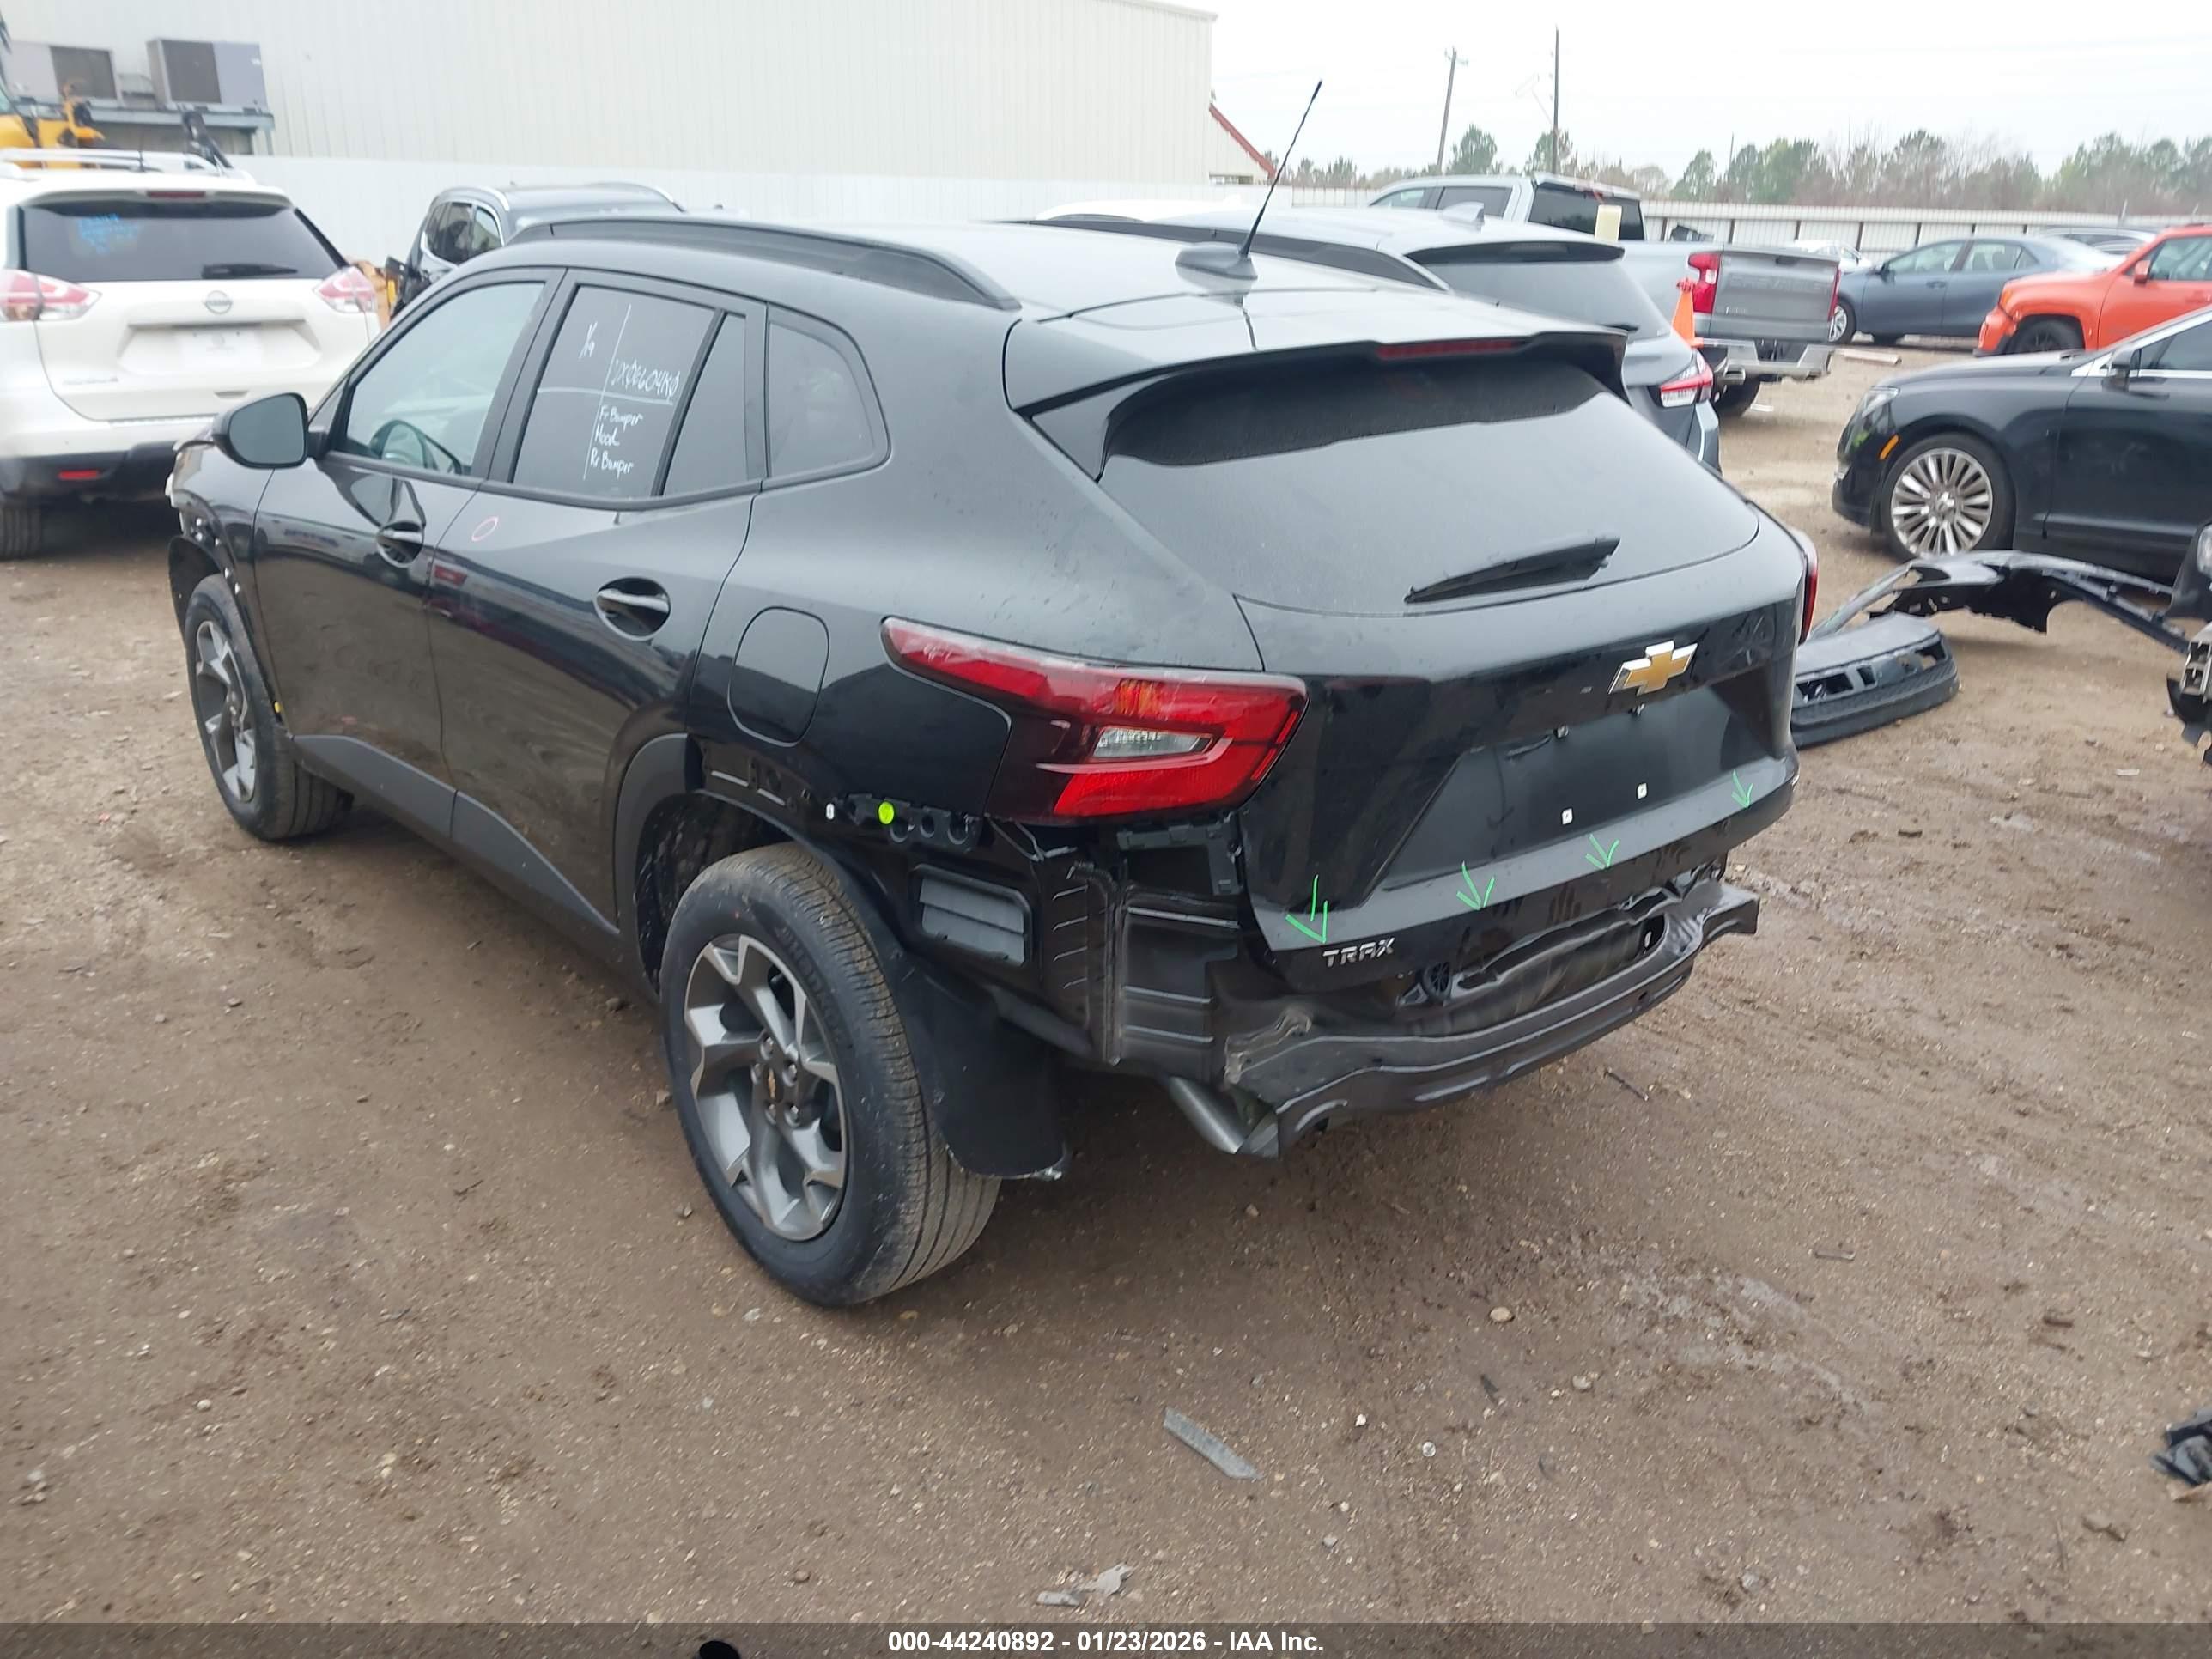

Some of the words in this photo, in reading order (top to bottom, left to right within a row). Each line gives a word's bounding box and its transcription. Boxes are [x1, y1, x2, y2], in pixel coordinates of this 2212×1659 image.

[594, 422, 620, 447] Hood
[601, 449, 634, 478] Bumper
[1322, 937, 1395, 968] TRAX
